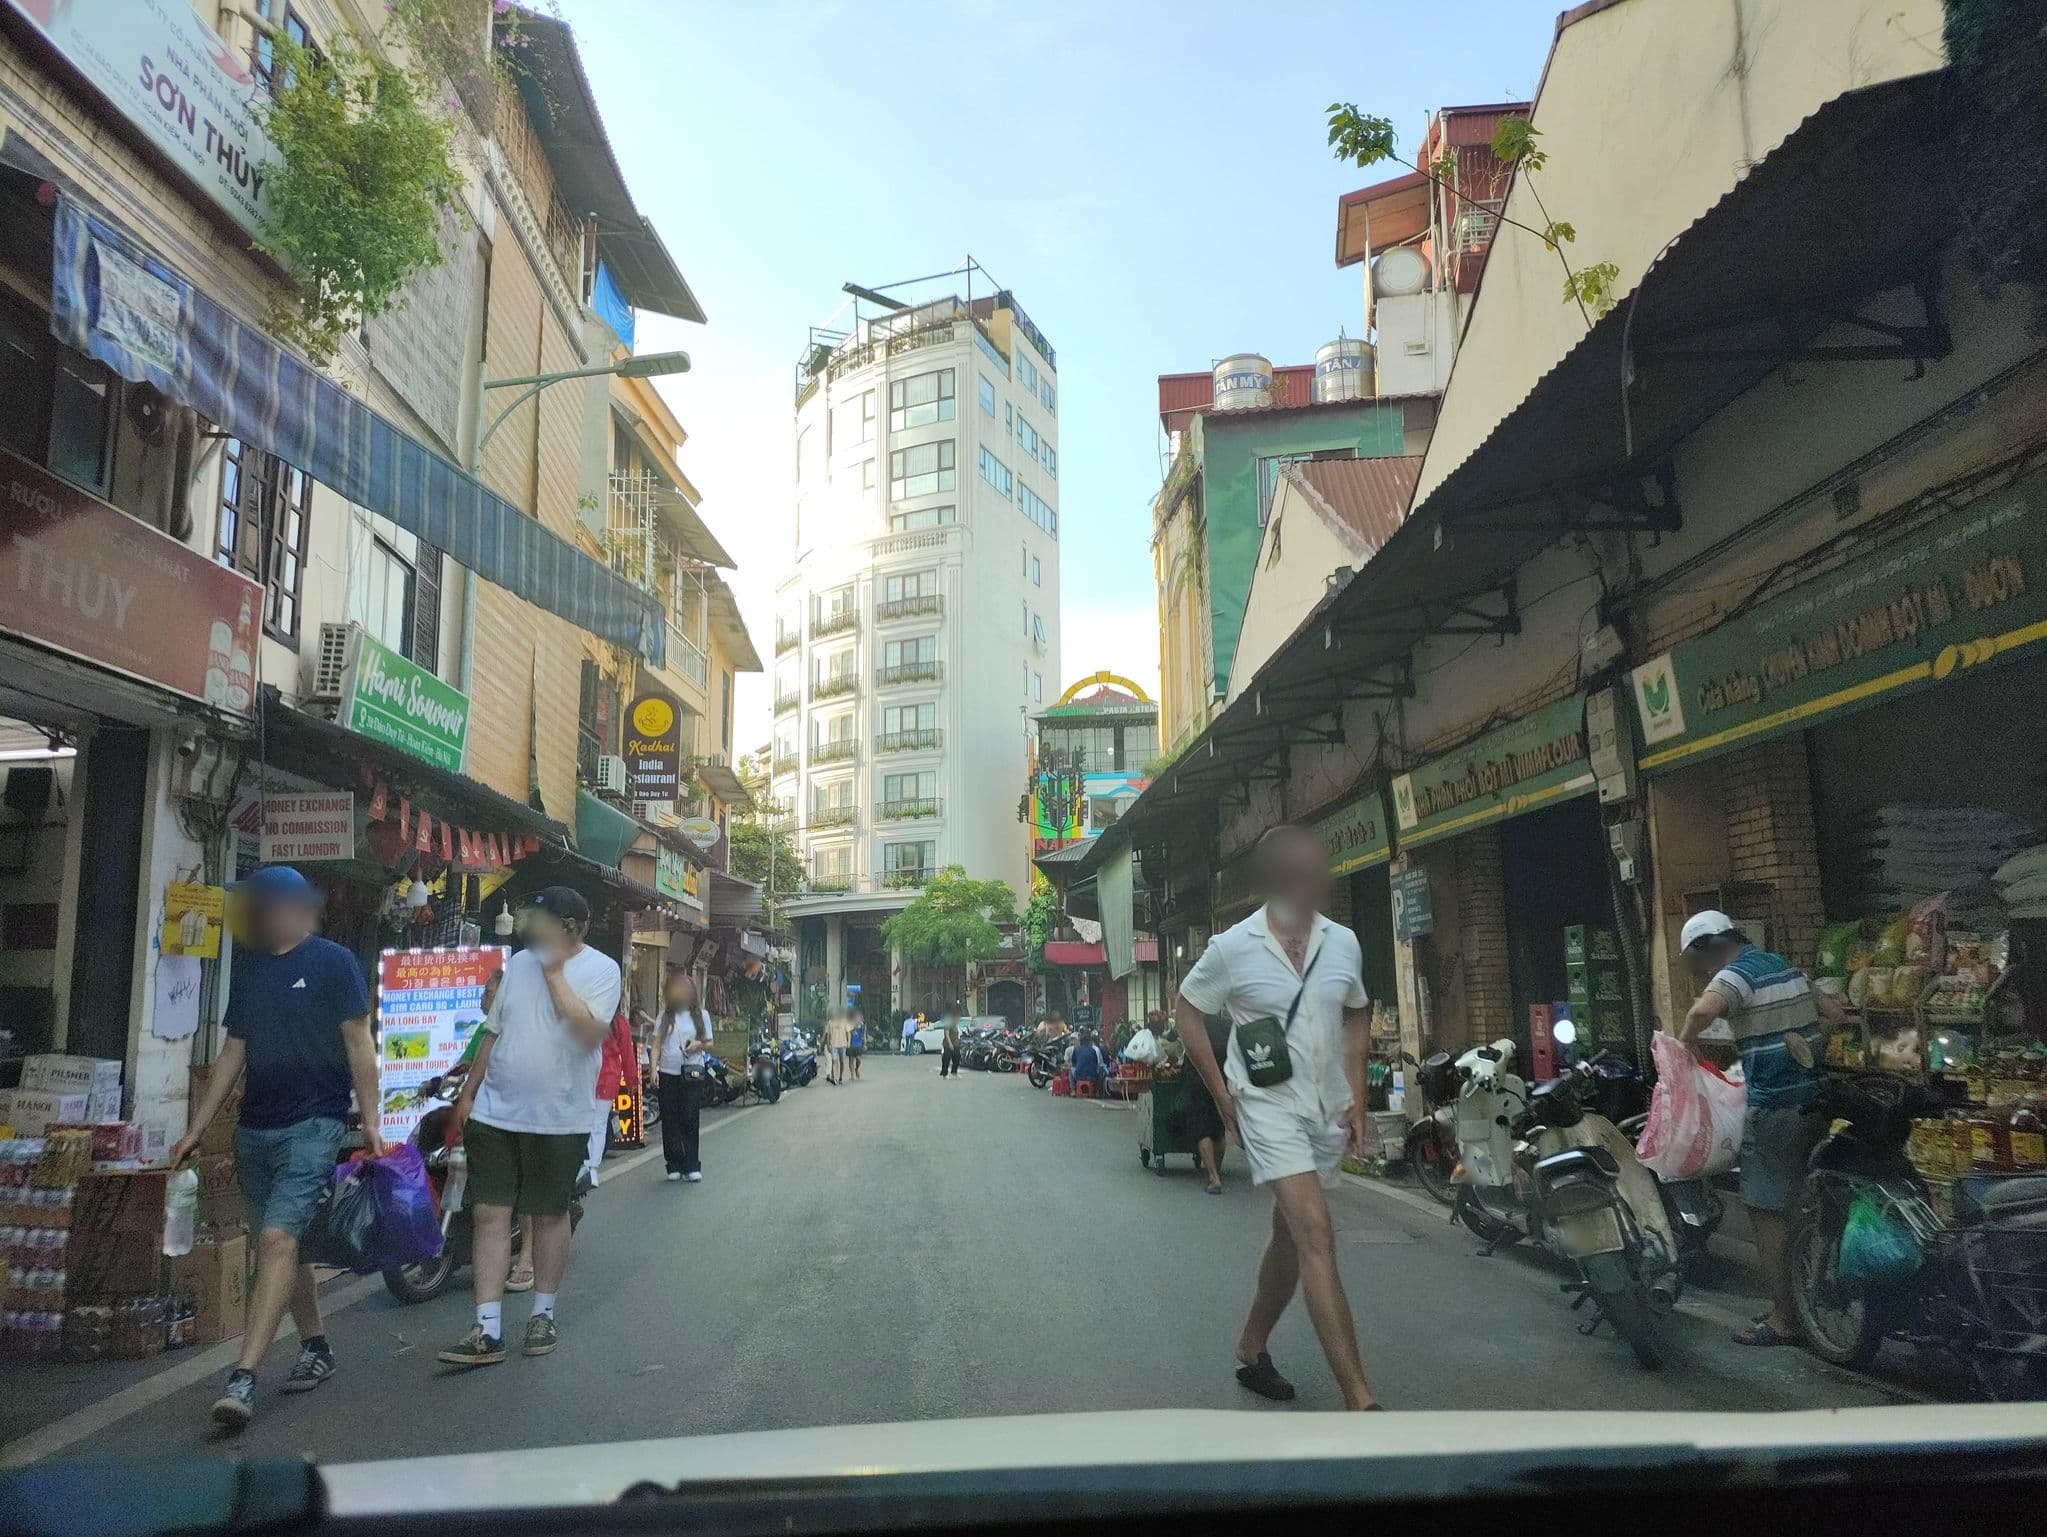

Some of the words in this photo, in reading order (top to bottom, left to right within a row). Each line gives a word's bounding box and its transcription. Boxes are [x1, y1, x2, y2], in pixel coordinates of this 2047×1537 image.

[139, 55, 196, 136] SƠN
[204, 116, 265, 201] THỦY
[628, 740, 675, 756] Kadhai
[639, 759, 663, 770] India
[299, 799, 351, 812] EXCHANGE
[265, 822, 279, 835] NO
[282, 820, 347, 834] COMMISSION
[272, 844, 296, 857] FAST
[297, 842, 341, 856] LAUNDRY
[383, 992, 412, 1003] MONEY
[413, 990, 455, 1001] EXCHANGE
[456, 989, 477, 999] BEST
[390, 1004, 408, 1013] SIM
[409, 1002, 434, 1012] CARD
[398, 1016, 420, 1025] LONG
[422, 1015, 438, 1024] BAY
[383, 1115, 410, 1126] DAILY
